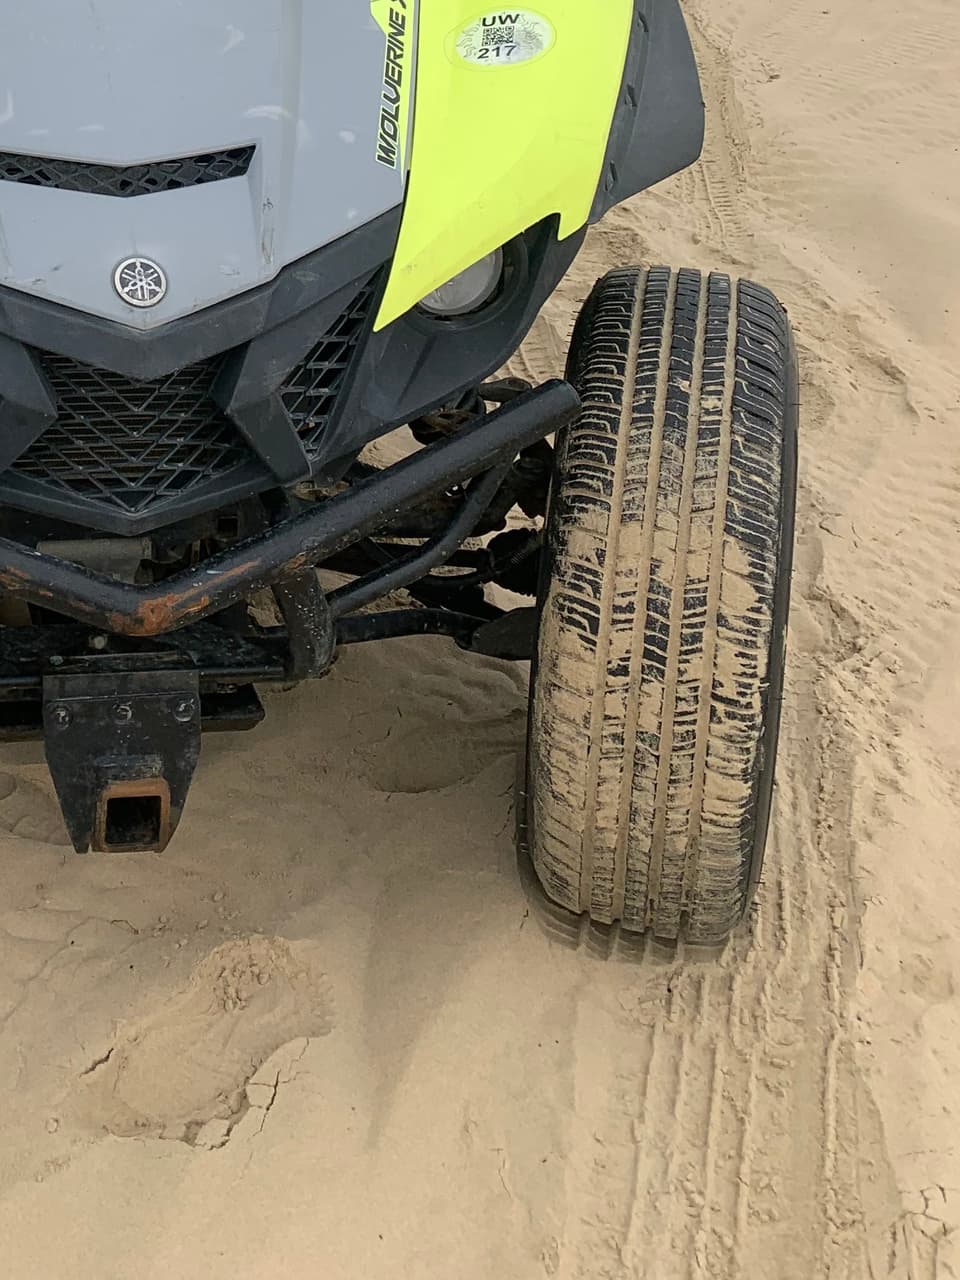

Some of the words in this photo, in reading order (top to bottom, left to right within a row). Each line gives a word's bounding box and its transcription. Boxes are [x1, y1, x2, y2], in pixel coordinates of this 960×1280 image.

[481, 13, 520, 27] UW
[477, 45, 518, 59] 217
[376, 7, 407, 168] WOLVERINE
